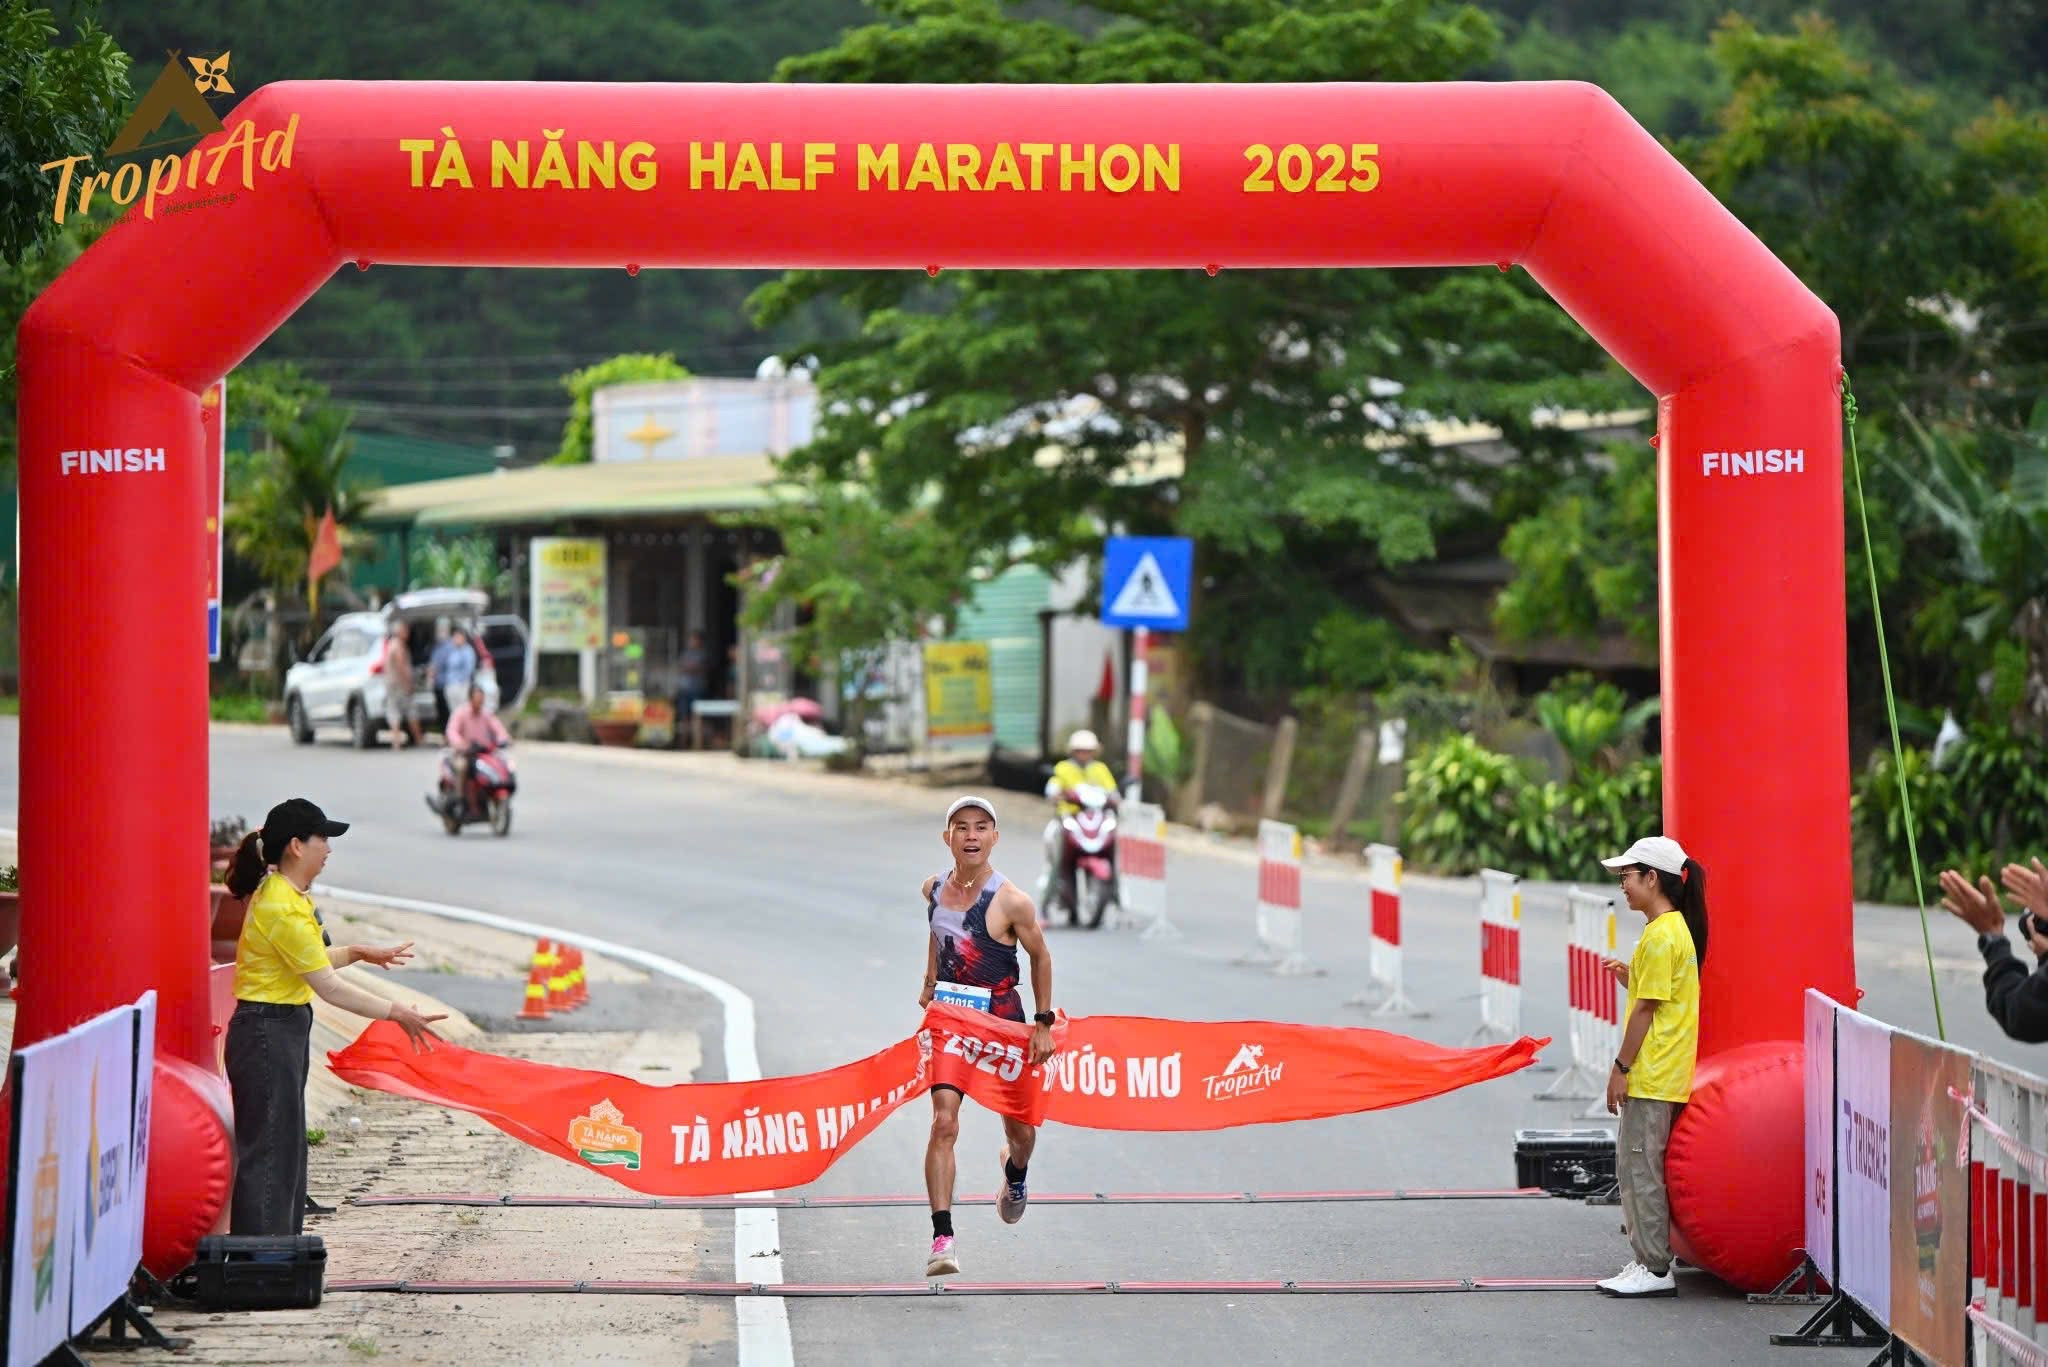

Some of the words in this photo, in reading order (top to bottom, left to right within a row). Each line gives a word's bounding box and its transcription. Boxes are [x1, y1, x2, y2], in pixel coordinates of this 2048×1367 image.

[400, 125, 474, 189] TÀ
[491, 128, 657, 191] NĂNG
[689, 141, 836, 191] HALF
[857, 142, 1180, 193] MARATHON
[1243, 143, 1380, 193] 2025
[61, 448, 165, 475] FINISH
[1702, 449, 1804, 476] FINISH
[671, 1114, 710, 1165] TÀ
[722, 1106, 808, 1159] NĂNG
[943, 1029, 1024, 1082] 2025
[1126, 1052, 1182, 1098] MƠ
[1854, 1111, 1887, 1190] TRUERACE
